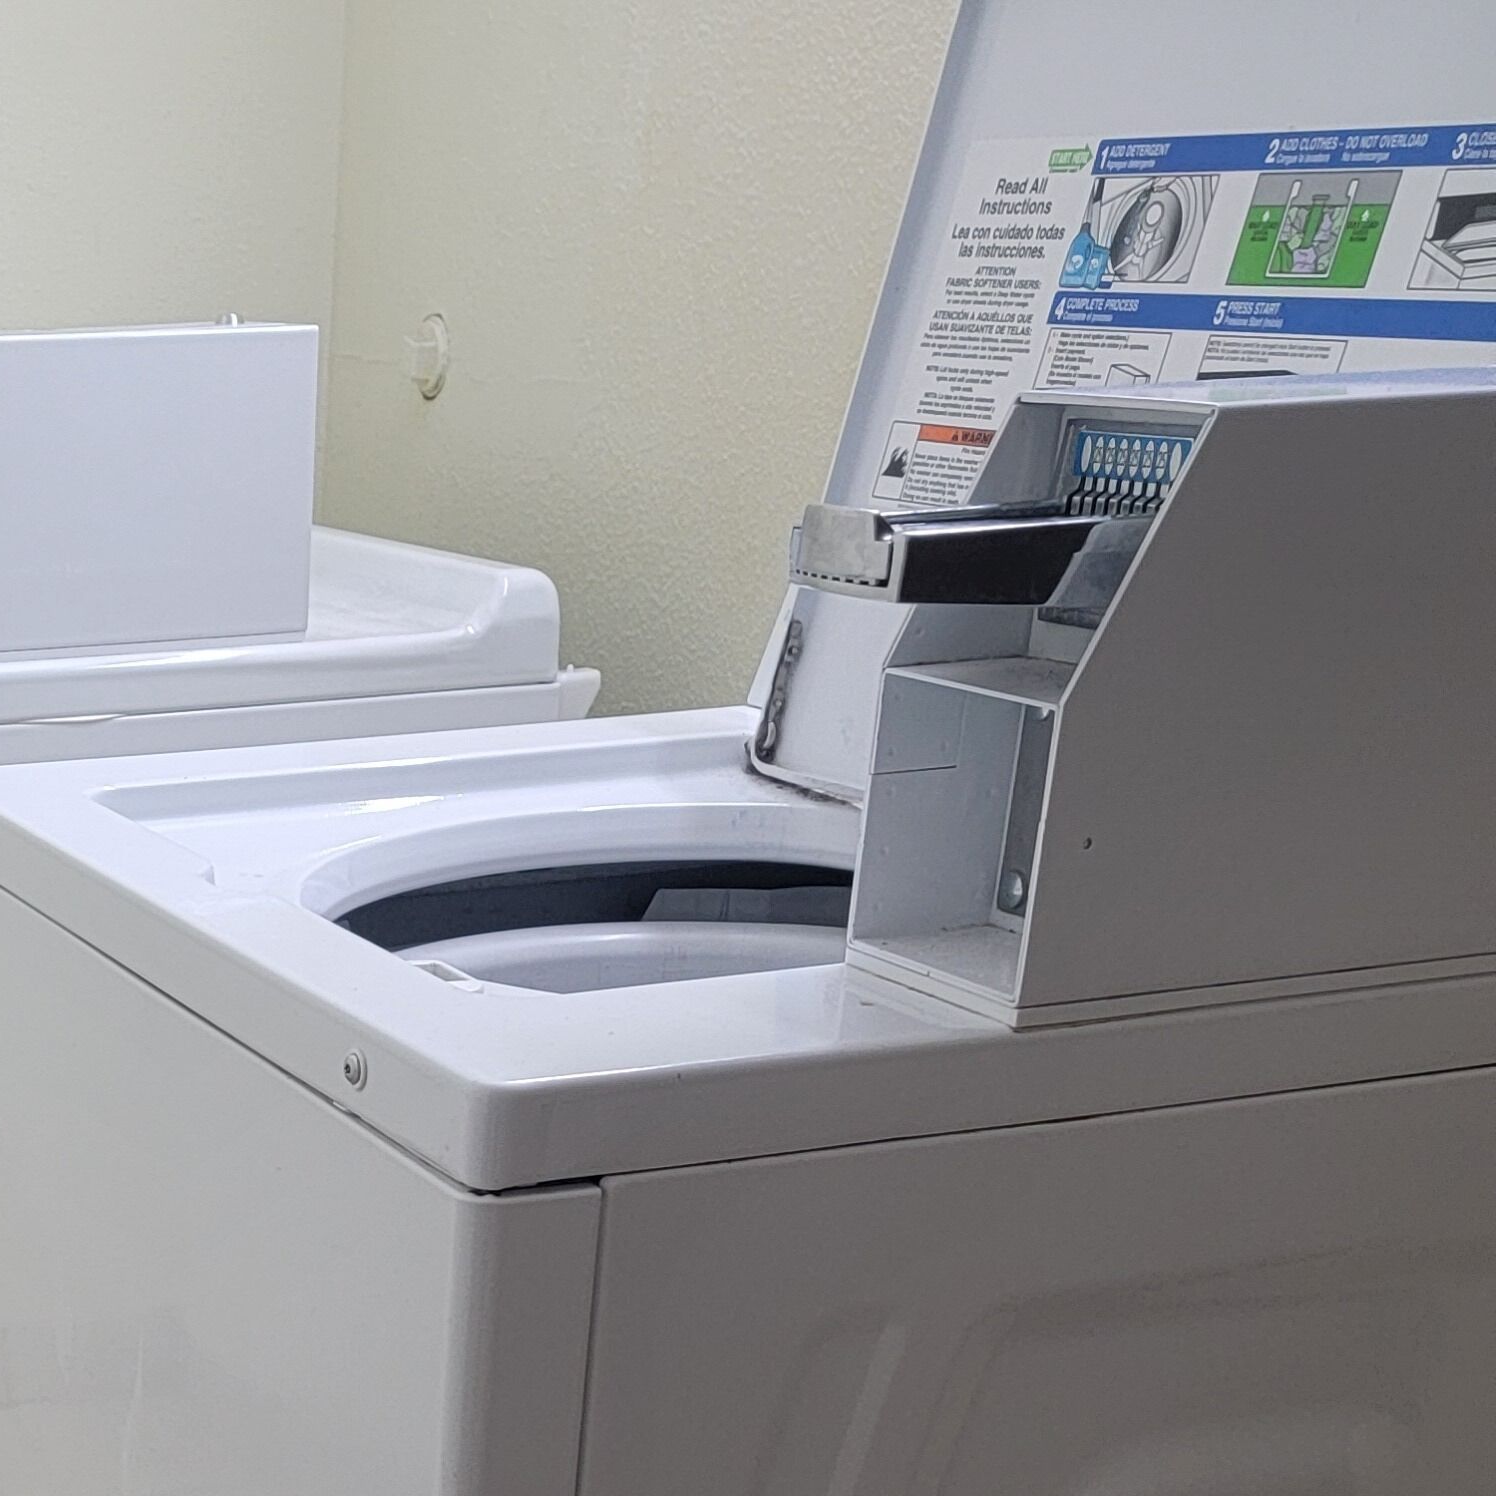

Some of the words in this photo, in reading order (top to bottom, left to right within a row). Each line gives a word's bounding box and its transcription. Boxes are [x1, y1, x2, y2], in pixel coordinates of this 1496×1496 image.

[1264, 138, 1280, 164] 2
[1281, 138, 1299, 151] ADD
[1299, 136, 1339, 151] CLOTHES
[1345, 135, 1360, 149] DO
[1359, 134, 1380, 149] NOT
[1378, 133, 1429, 149] OVERLOAD
[1451, 132, 1468, 160] 3
[1100, 145, 1110, 170] 1
[1109, 145, 1126, 158] ADD
[1125, 143, 1171, 157] DETERGENT
[995, 178, 1028, 195] Read
[1029, 176, 1049, 194] All
[979, 198, 1053, 215] Instructions
[951, 224, 971, 240] Lea
[971, 227, 991, 240] con
[992, 224, 1034, 240] cuidado
[1035, 224, 1066, 241] todas
[958, 242, 974, 258] las
[974, 242, 1046, 259] instrucciones.
[975, 266, 1017, 277] ATTENTION
[945, 277, 972, 288] FABRIC
[972, 279, 1012, 289] SOFTENER
[1013, 280, 1042, 290] USERS:
[933, 310, 968, 321] ATENCIÓN
[969, 313, 975, 321] A
[976, 312, 1016, 323] AQUÉLLOS
[1017, 314, 1034, 323] QUE
[1055, 297, 1066, 320] 4
[1066, 297, 1105, 310] COMPLETE
[1104, 298, 1140, 312] PROCESS
[1213, 300, 1228, 325] 5
[1227, 301, 1254, 315] PRESS
[1253, 302, 1281, 316] START
[929, 322, 949, 332] USAN
[949, 323, 993, 334] SUAVIZANTE
[994, 325, 1006, 335] DE
[1006, 326, 1032, 336] TELAS:
